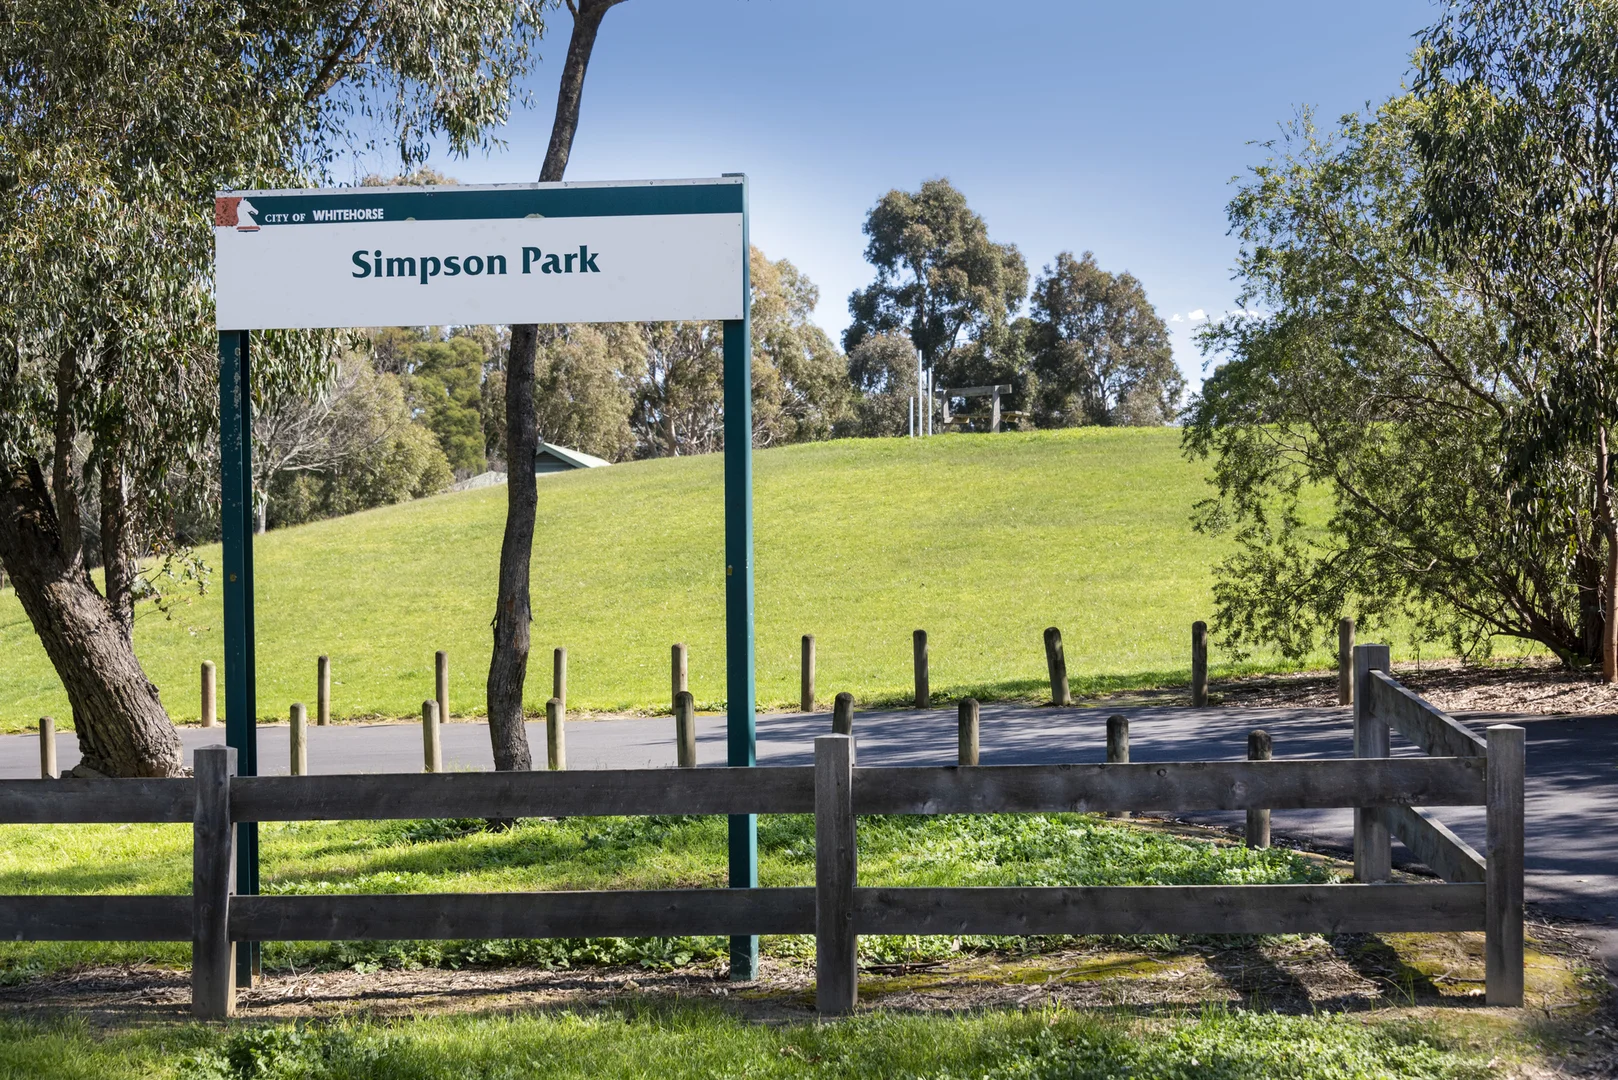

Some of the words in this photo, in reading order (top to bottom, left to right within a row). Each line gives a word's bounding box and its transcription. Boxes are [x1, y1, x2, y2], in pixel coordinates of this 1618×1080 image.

[265, 213, 289, 223] CITY
[292, 213, 306, 222] OF
[313, 208, 384, 221] WHITEHORSE
[352, 249, 507, 285] Simpson
[521, 245, 600, 275] Park
